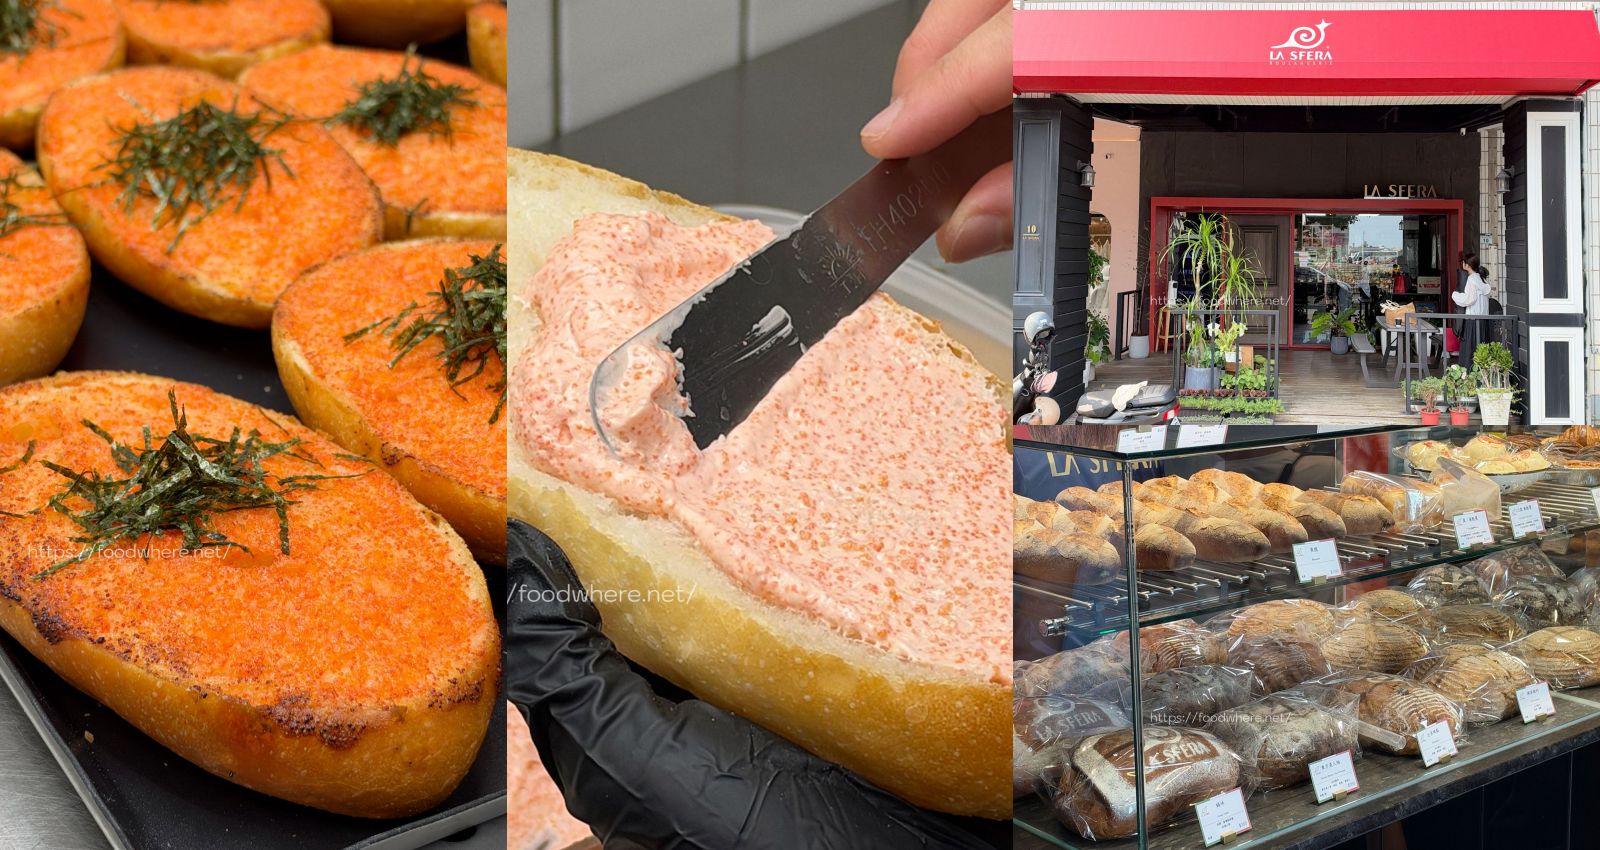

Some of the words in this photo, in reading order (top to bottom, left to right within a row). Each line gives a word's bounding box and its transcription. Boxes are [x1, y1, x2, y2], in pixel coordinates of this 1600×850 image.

[1269, 51, 1284, 60] LA
[1290, 51, 1332, 60] SFERA
[1364, 184, 1380, 197] LA
[1388, 184, 1438, 198] SFERA
[1057, 710, 1103, 733] SFERA
[1162, 741, 1211, 764] SFERA
